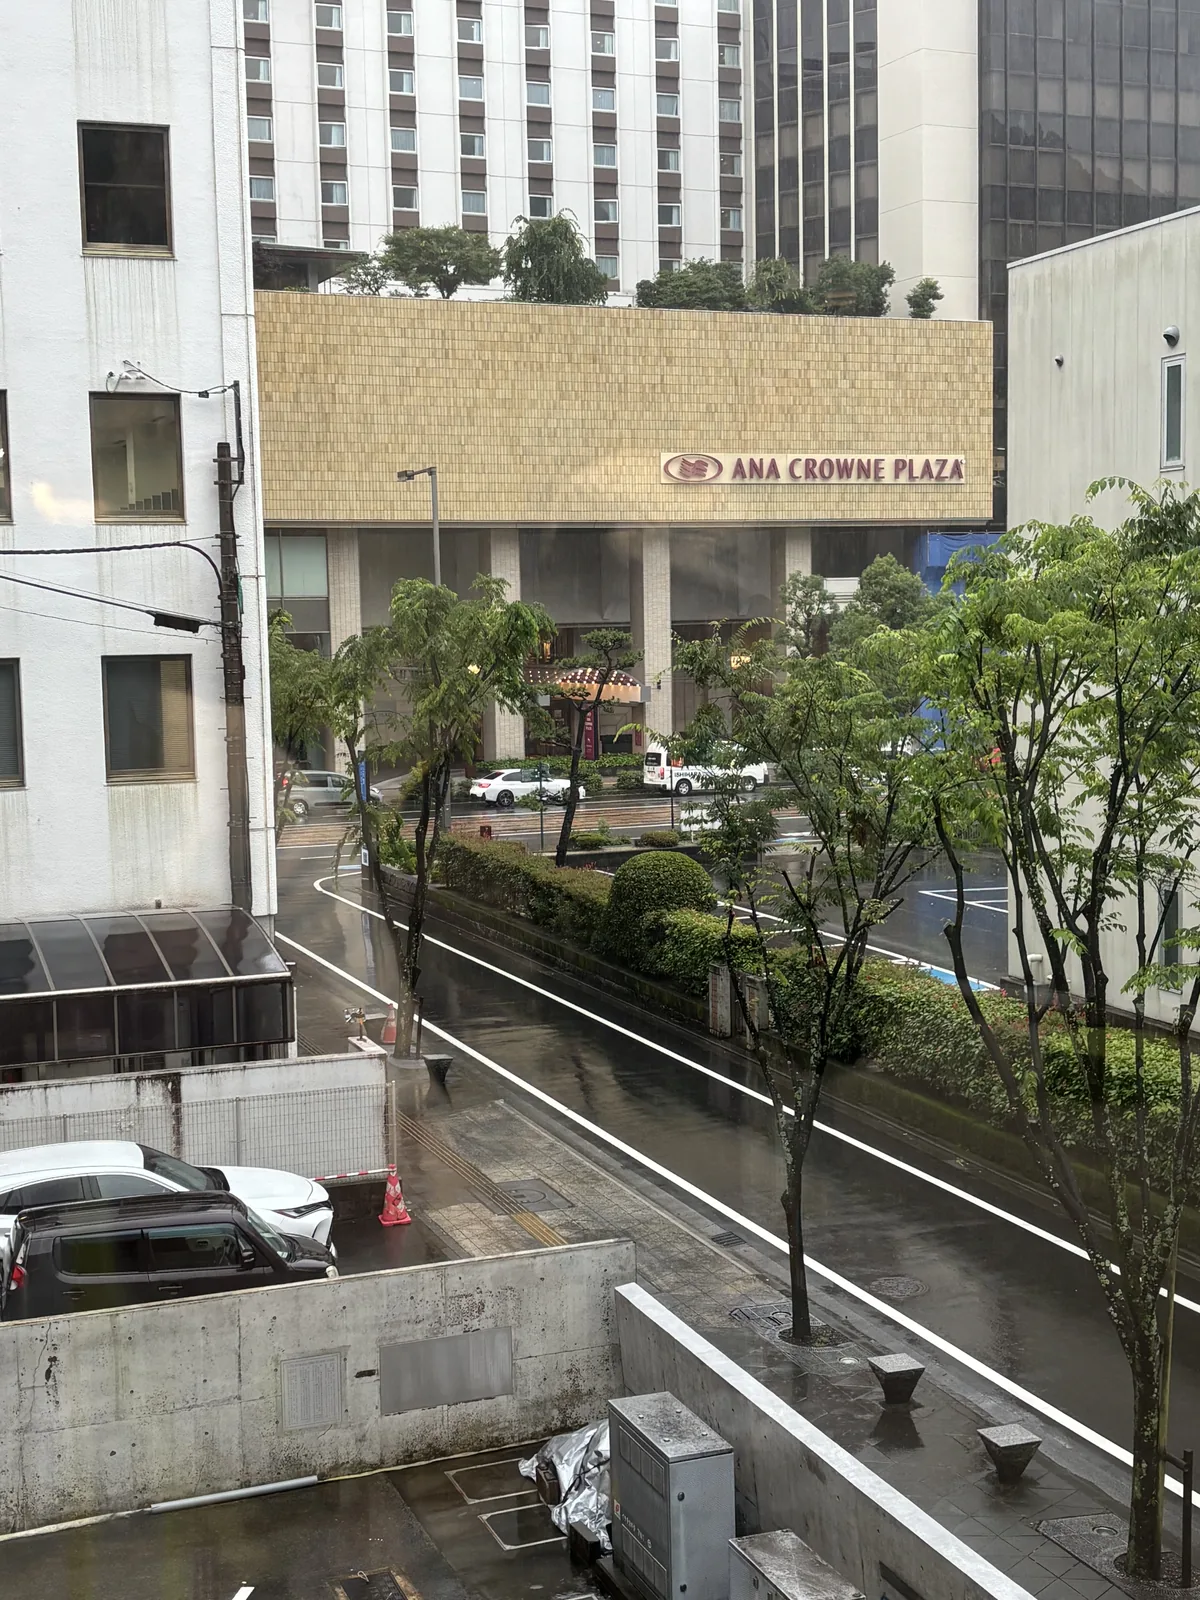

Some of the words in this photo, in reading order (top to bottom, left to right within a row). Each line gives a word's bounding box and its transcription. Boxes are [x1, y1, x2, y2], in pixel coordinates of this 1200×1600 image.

[731, 457, 781, 480] ANA
[788, 458, 885, 481] CROWNE
[894, 458, 964, 481] PLAZA
